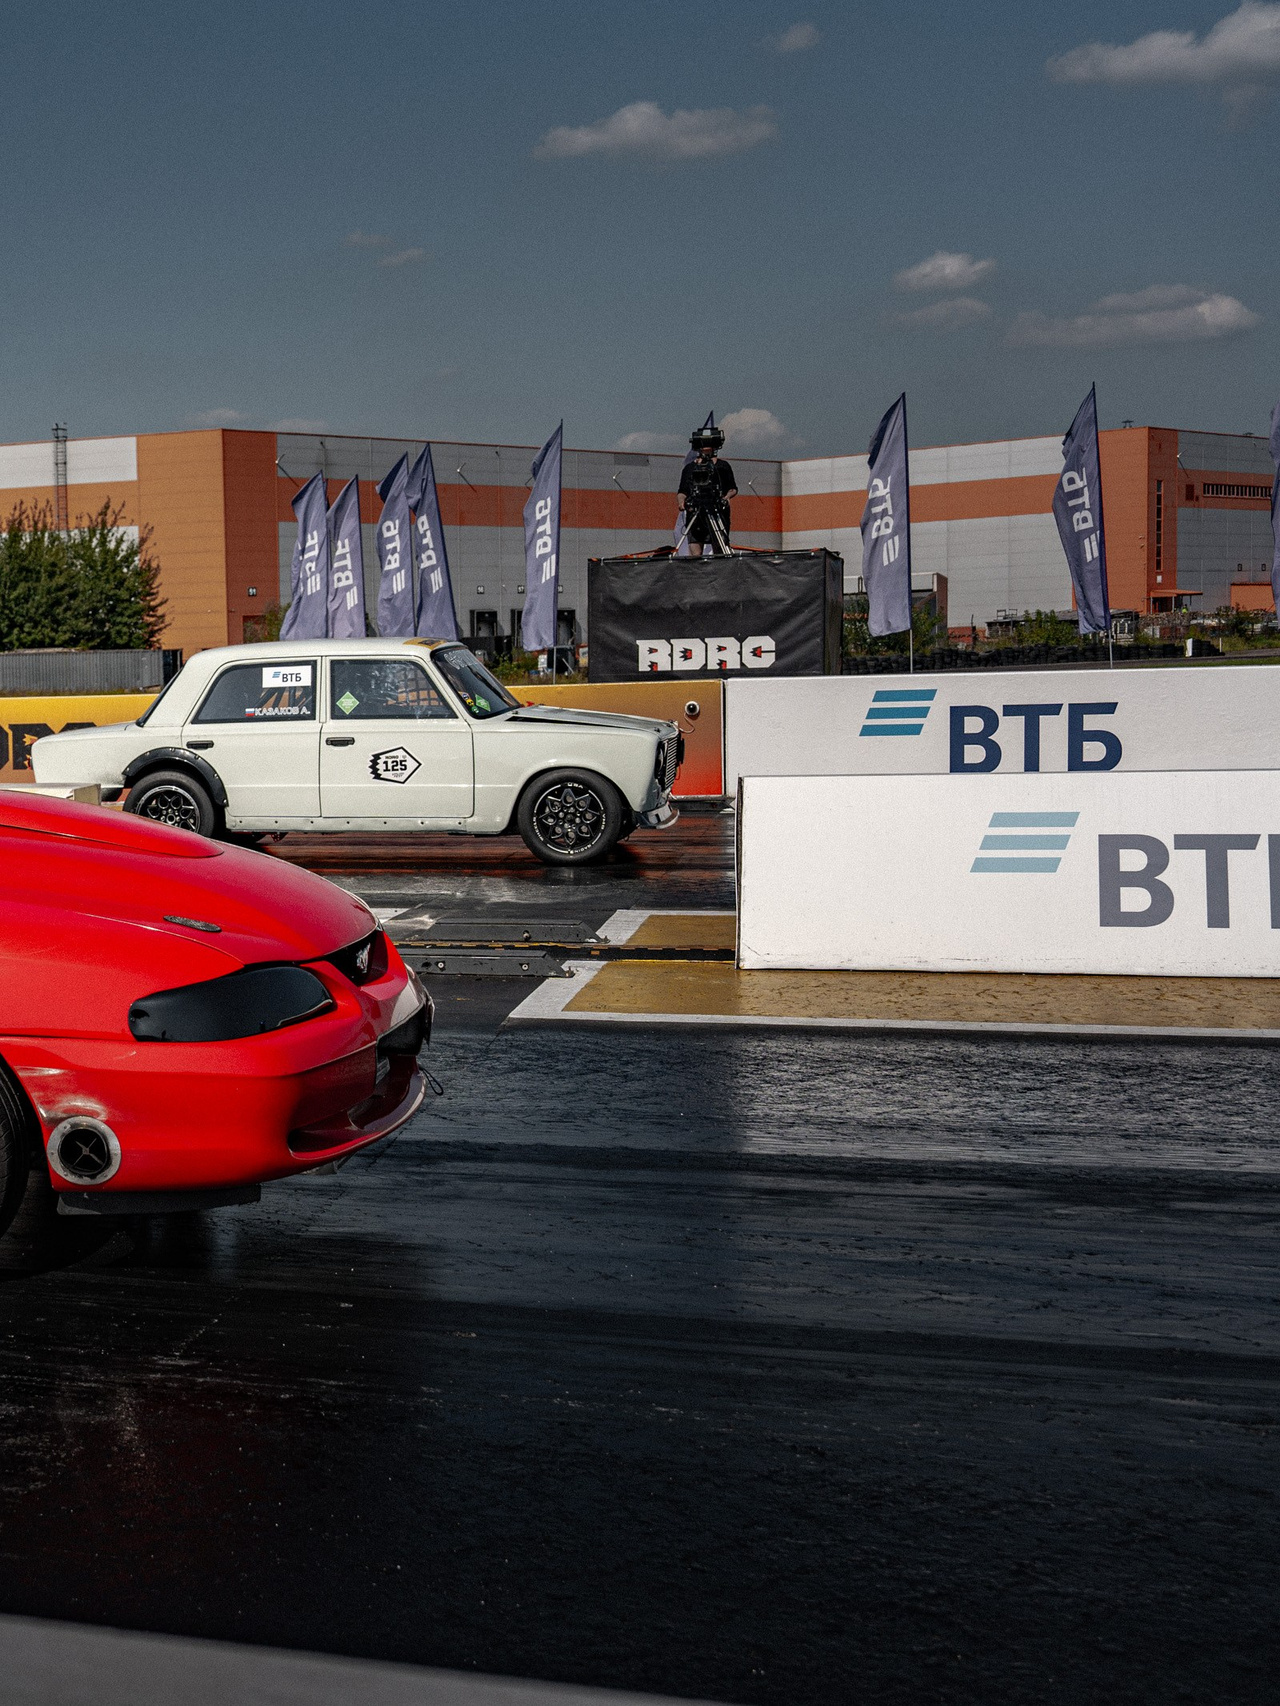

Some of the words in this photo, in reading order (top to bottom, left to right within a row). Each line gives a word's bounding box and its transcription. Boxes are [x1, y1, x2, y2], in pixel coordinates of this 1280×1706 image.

[636, 635, 776, 672] RDRC
[281, 672, 302, 683] ВТБ
[254, 707, 299, 717] КАЗАКОВ
[949, 701, 1123, 773] ВТБ
[383, 759, 408, 772] 125
